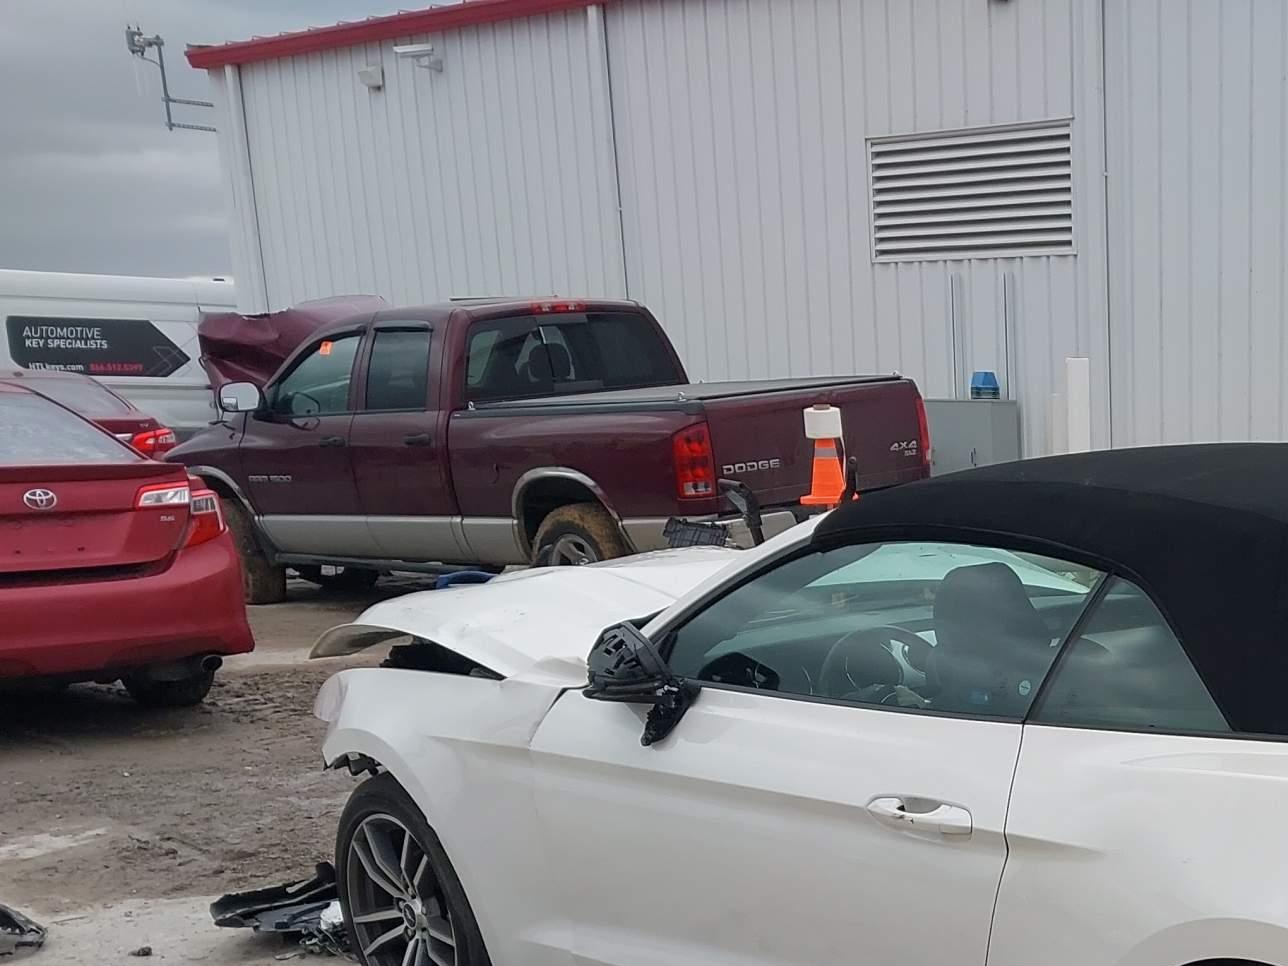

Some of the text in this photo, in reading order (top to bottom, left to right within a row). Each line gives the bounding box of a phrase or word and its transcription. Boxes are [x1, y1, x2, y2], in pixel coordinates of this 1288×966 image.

[23, 326, 101, 339] AUTOMOTIVE
[25, 338, 108, 349] KEY SPECIALISTS
[723, 459, 781, 475] DODGE
